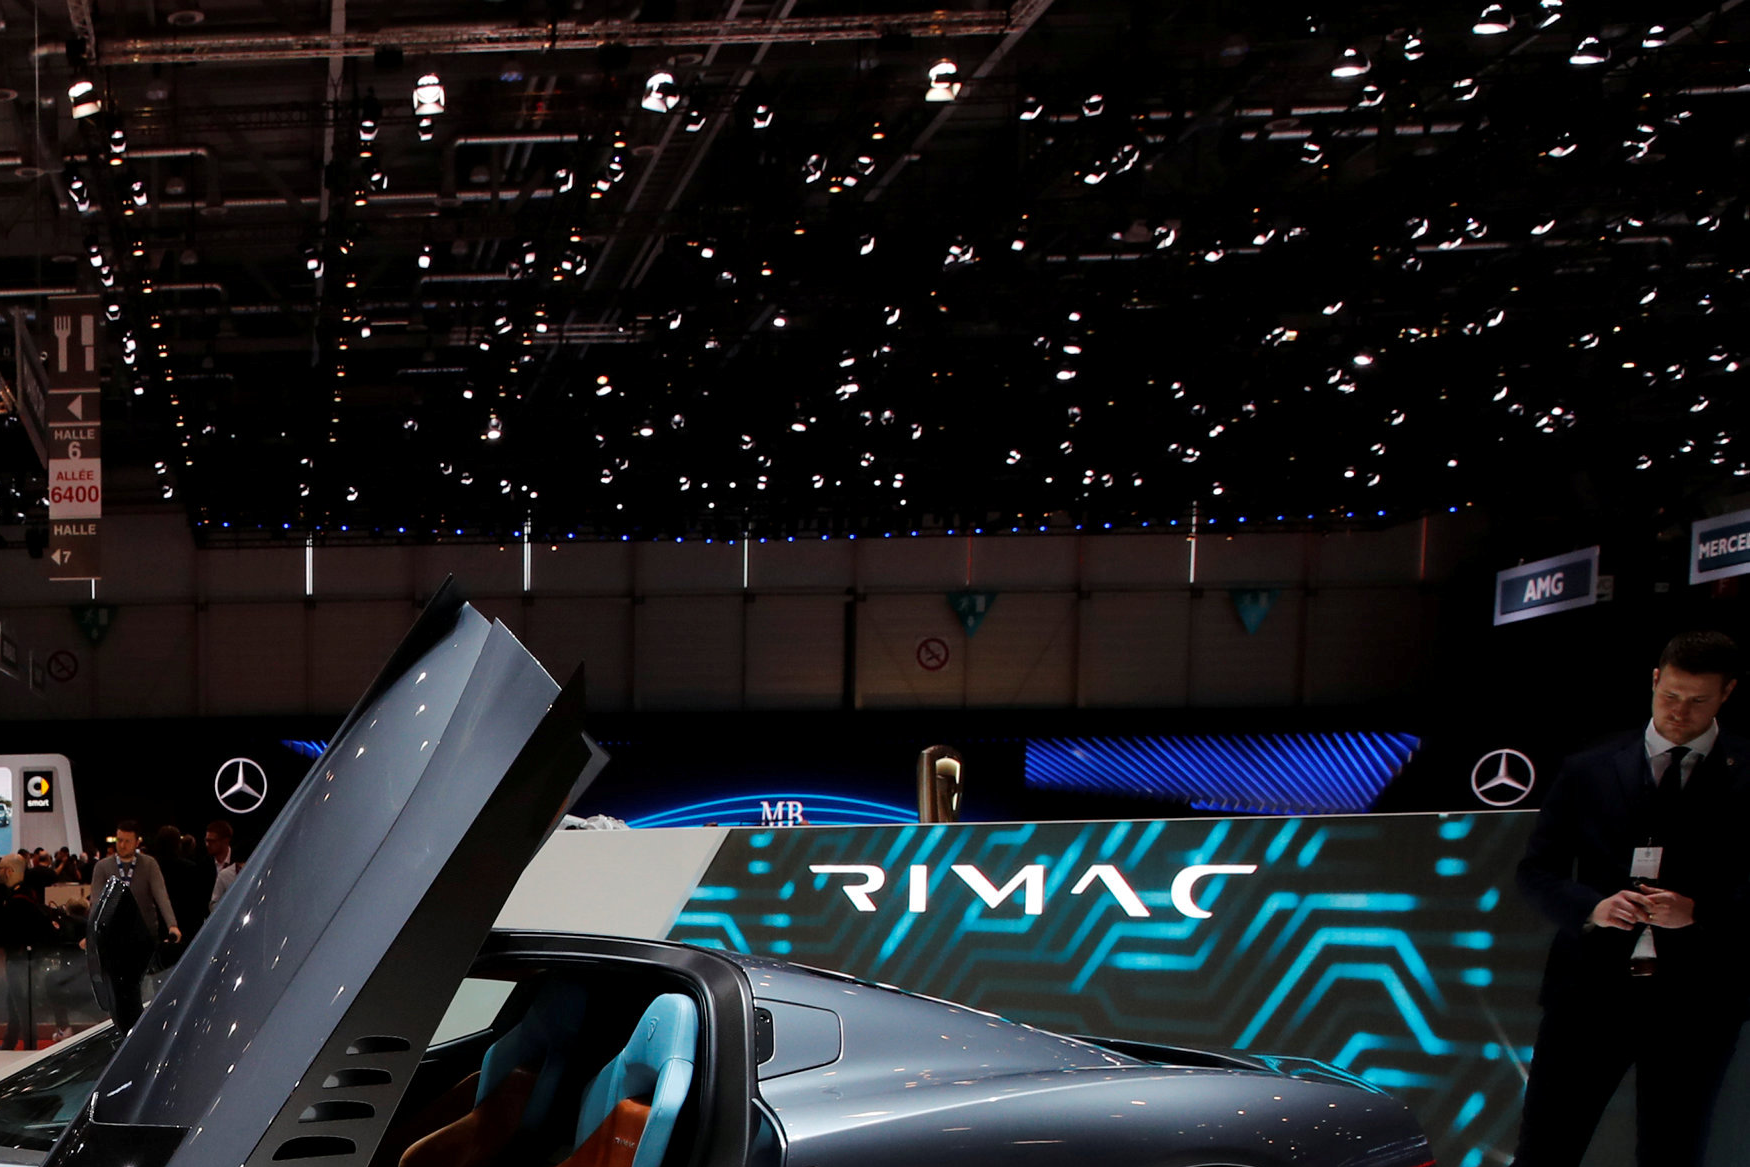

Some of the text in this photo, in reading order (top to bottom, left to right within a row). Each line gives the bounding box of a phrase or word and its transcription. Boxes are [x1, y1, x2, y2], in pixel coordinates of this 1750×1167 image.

[53, 429, 95, 441] HALLE
[67, 441, 82, 460] 6
[55, 468, 94, 481] ALLÉE
[50, 485, 99, 504] 6400
[53, 524, 97, 536] HALLE
[62, 550, 73, 563] 7
[1523, 572, 1565, 603] AMG
[26, 799, 50, 808] smart
[807, 863, 1259, 919] RIMAC
